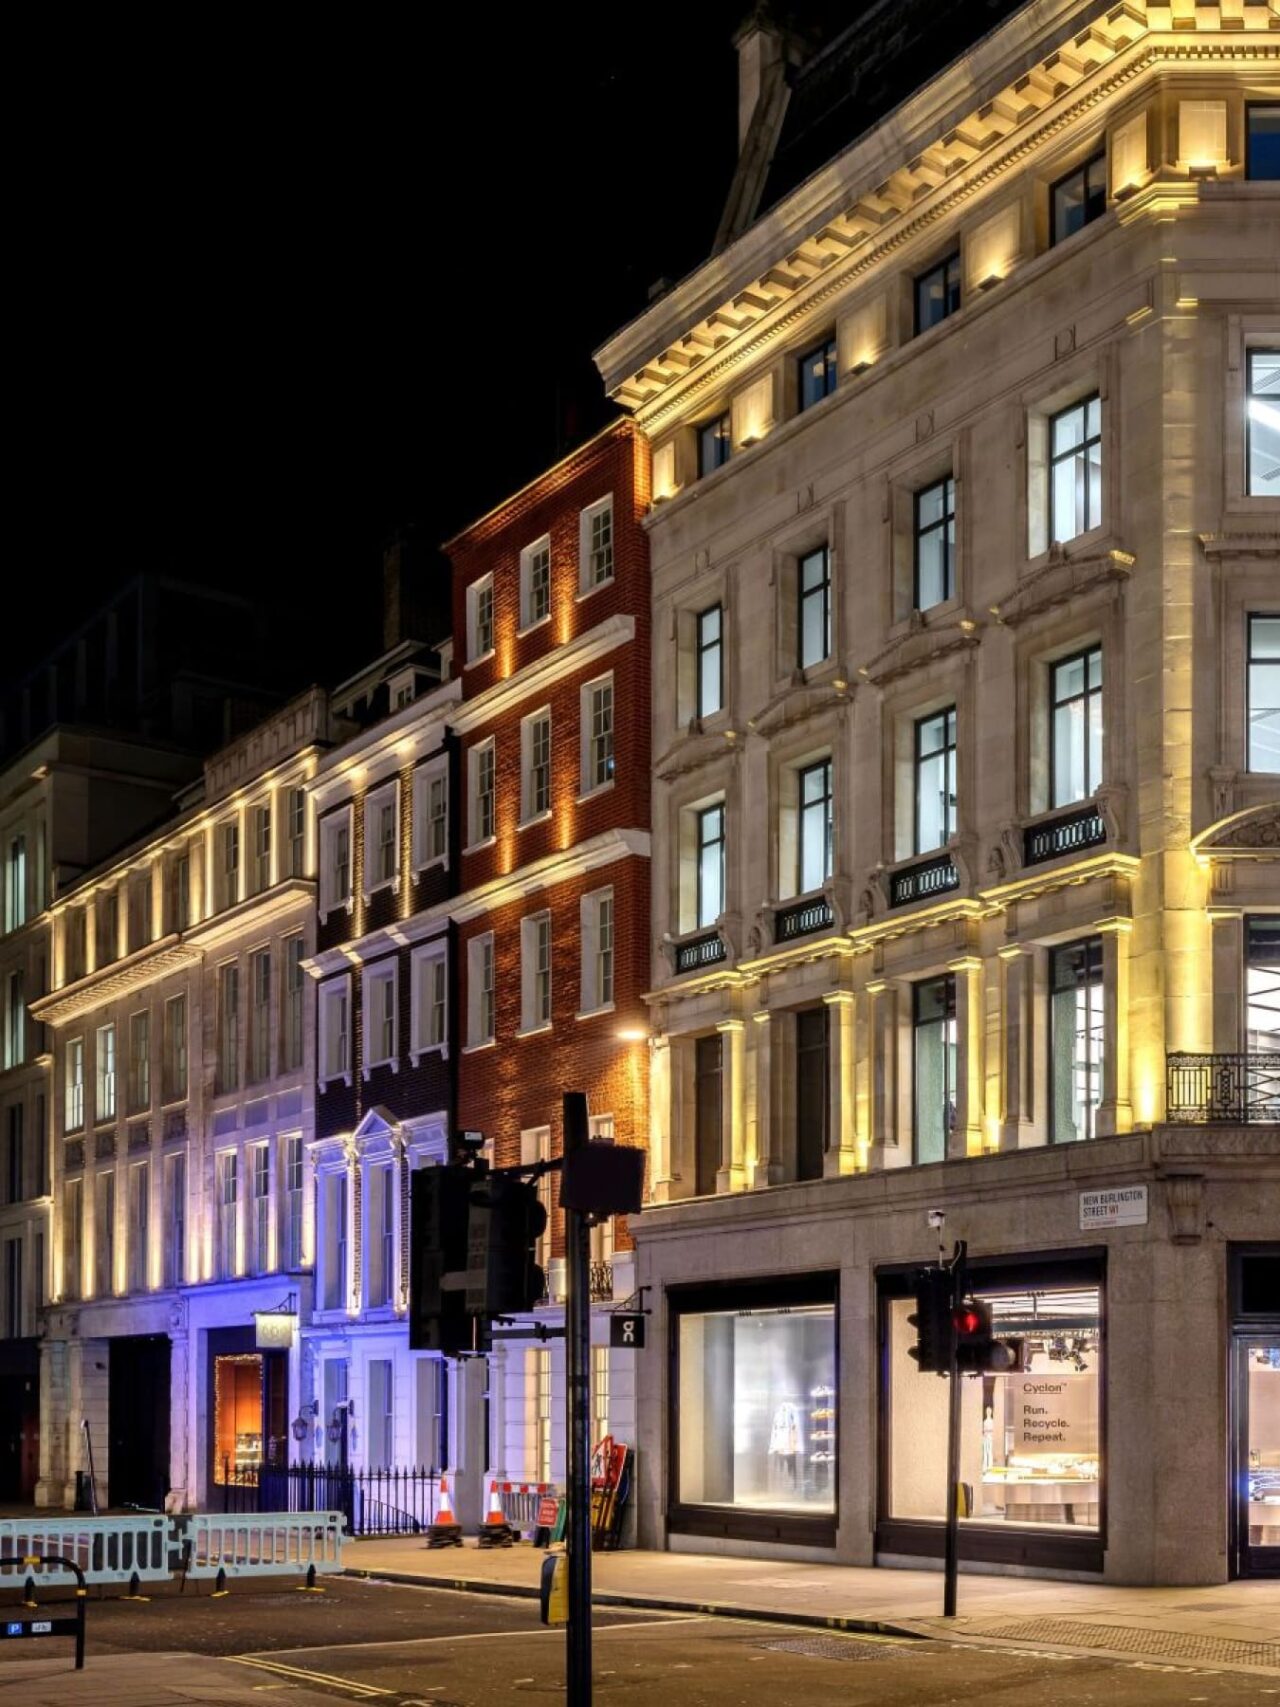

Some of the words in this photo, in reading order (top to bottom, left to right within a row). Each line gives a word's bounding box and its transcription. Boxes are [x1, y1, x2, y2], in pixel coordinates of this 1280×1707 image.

[1083, 1195, 1098, 1206] NEW
[1083, 1206, 1107, 1218] STREET
[1108, 1205, 1118, 1215] W1
[1023, 1405, 1048, 1414] Run.
[1023, 1419, 1070, 1429] Recycle.
[1023, 1432, 1066, 1442] Repeat.
[11, 1623, 20, 1634] P
